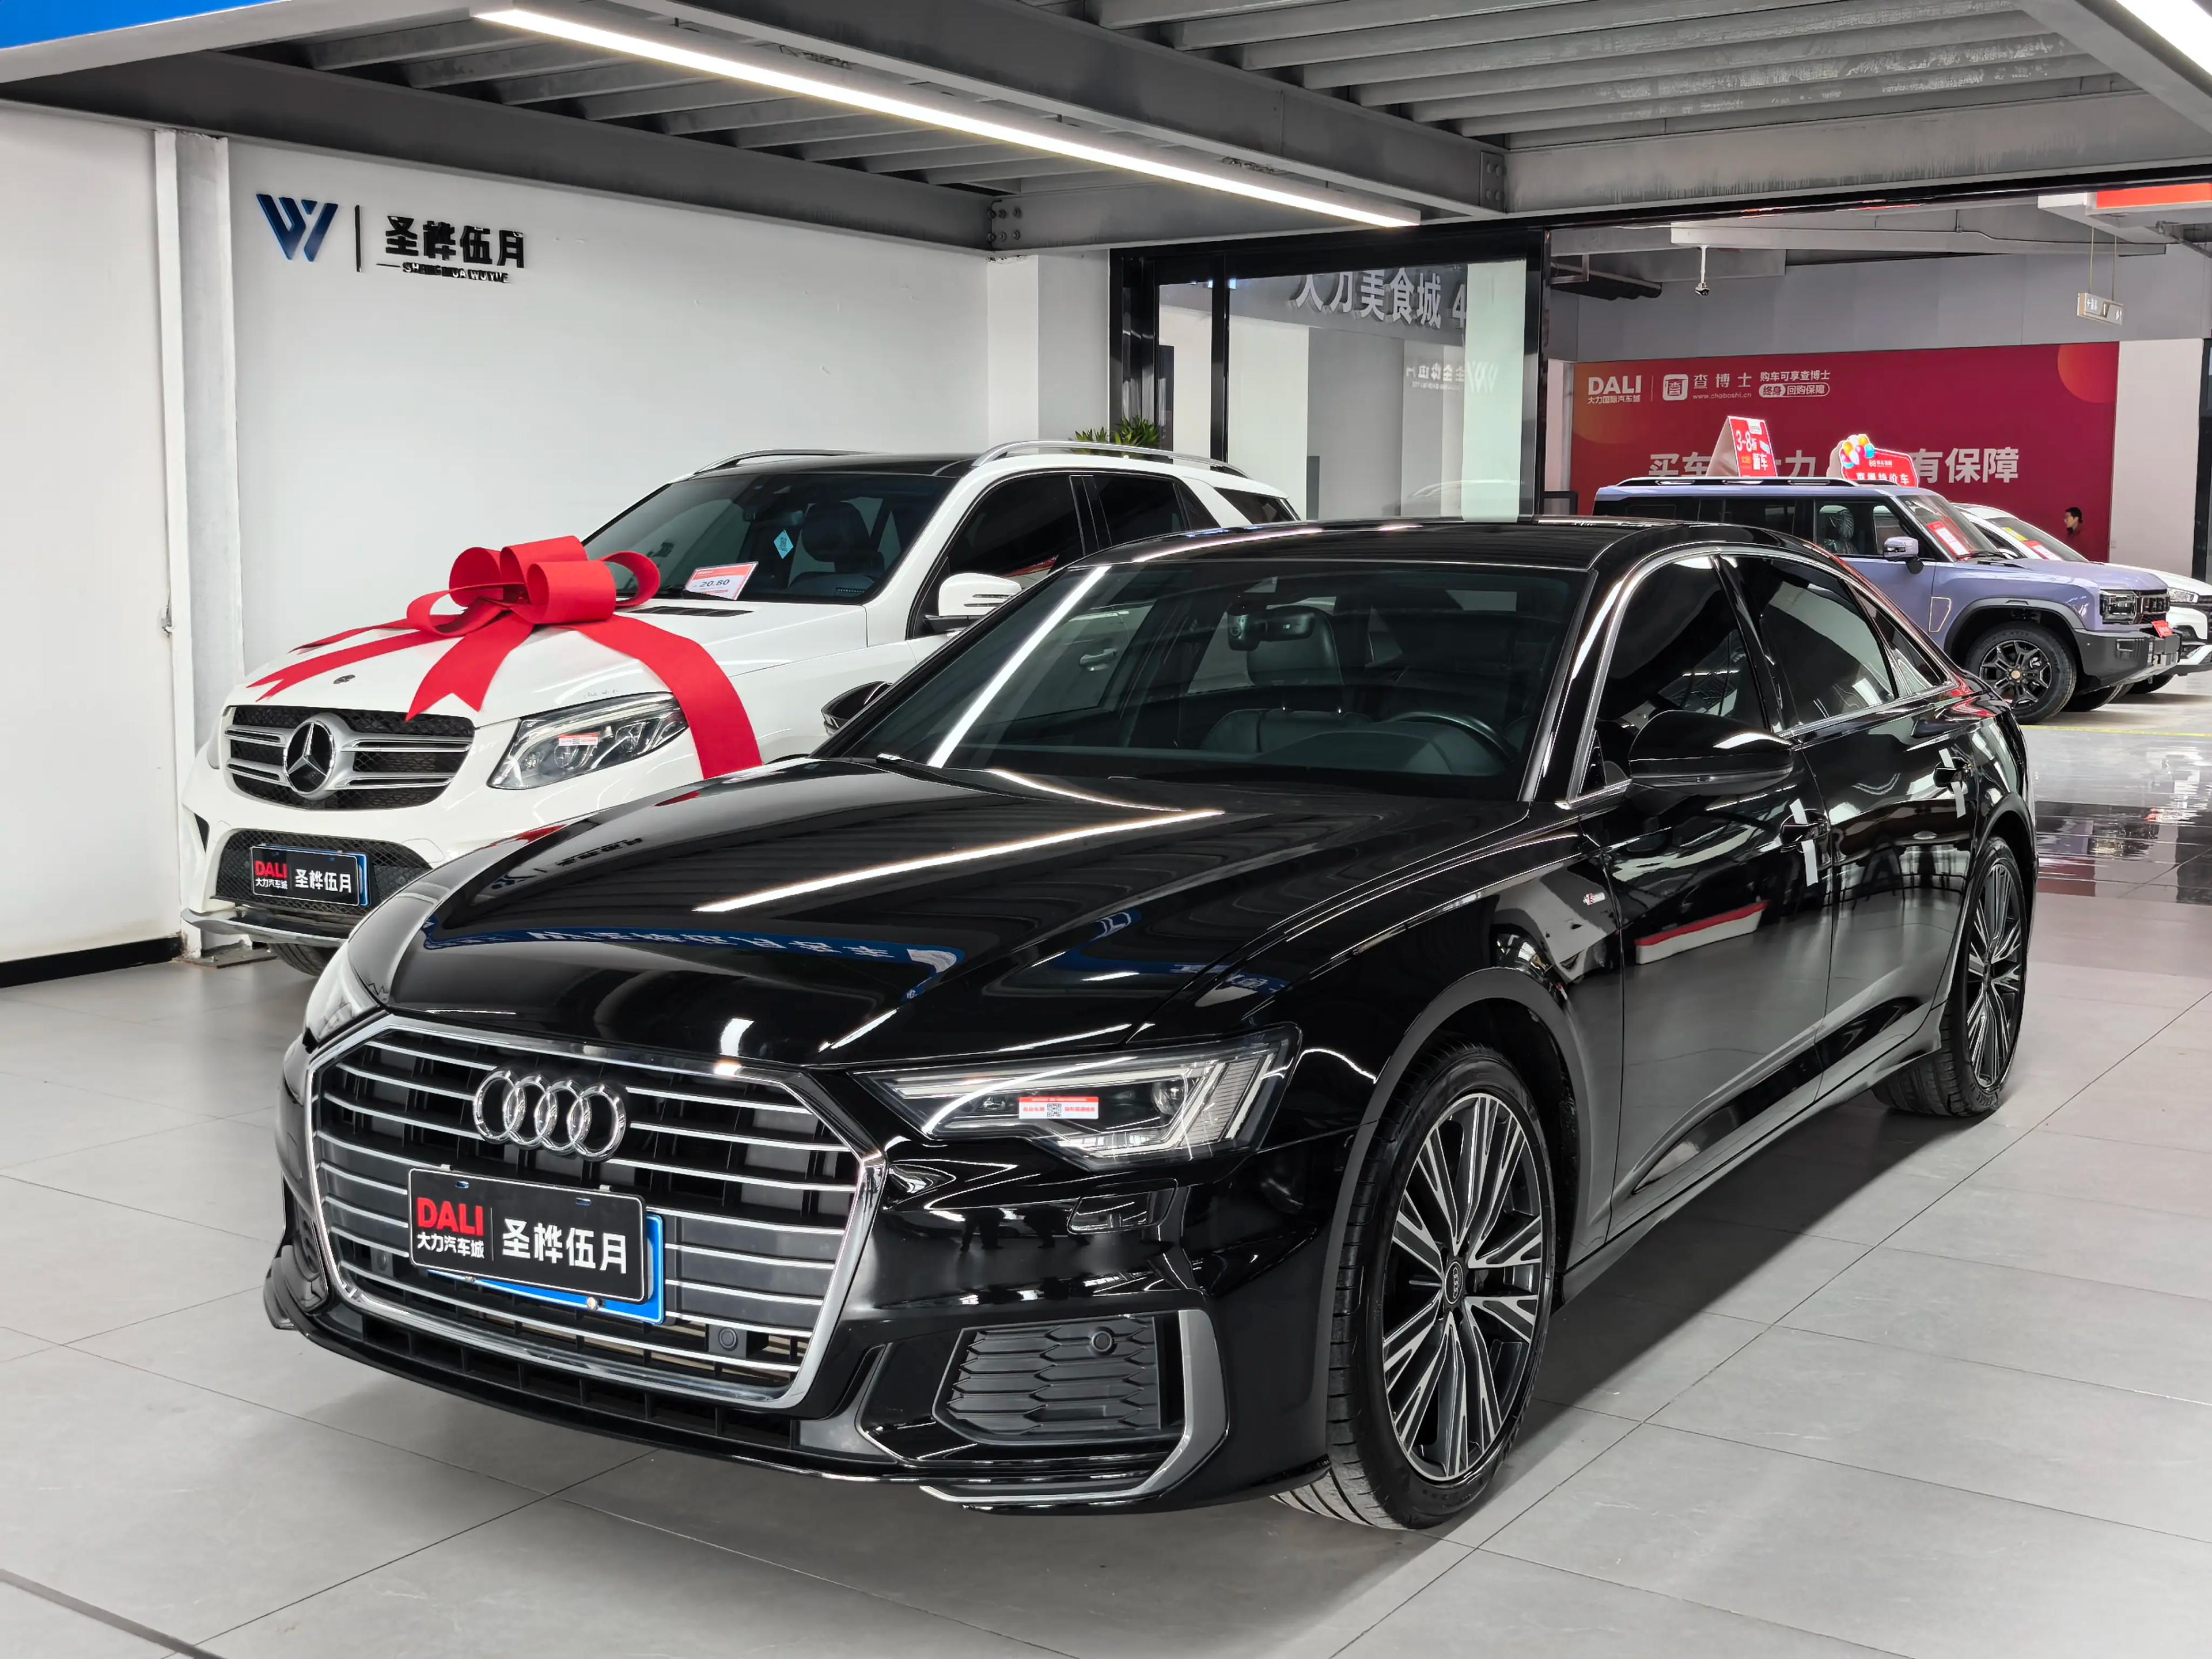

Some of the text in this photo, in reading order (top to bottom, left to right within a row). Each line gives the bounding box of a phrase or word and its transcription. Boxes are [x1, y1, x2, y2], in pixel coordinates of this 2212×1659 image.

[385, 215, 525, 268] 圣桦伍月
[1588, 375, 1642, 395] DALI
[1760, 370, 1830, 382] 购车可享查博士
[254, 861, 287, 878] DALI
[295, 869, 351, 893] 圣桦伍月
[416, 1197, 484, 1236] DALI
[416, 1232, 484, 1259] 大力汽车城
[502, 1218, 627, 1274] 圣桦伍月
